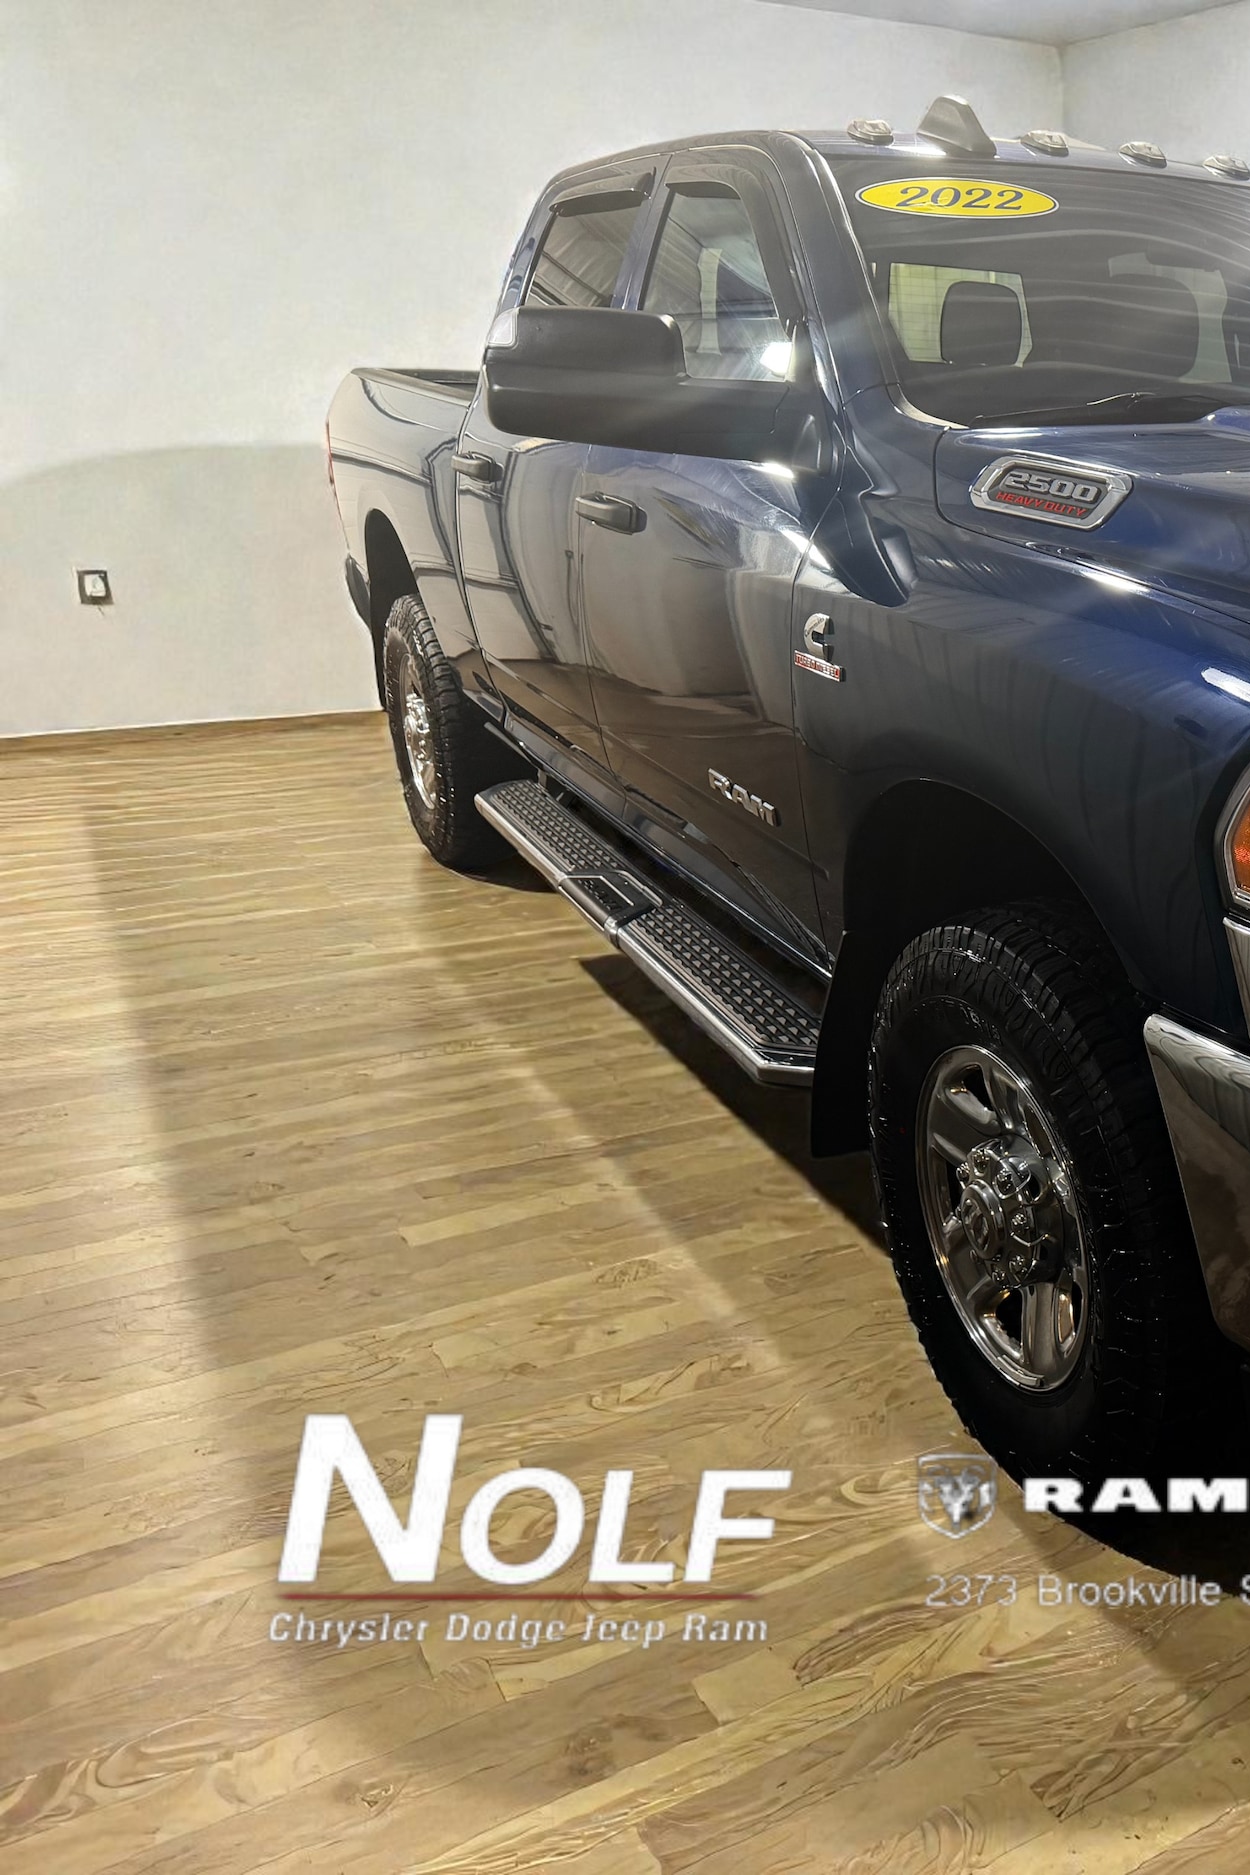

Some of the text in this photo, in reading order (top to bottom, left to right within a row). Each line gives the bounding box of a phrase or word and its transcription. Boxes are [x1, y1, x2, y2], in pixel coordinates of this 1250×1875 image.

[895, 186, 1024, 211] 2022
[1004, 471, 1100, 502] 2500
[996, 490, 1088, 517] HEAVY DUTY
[708, 767, 777, 827] RAM
